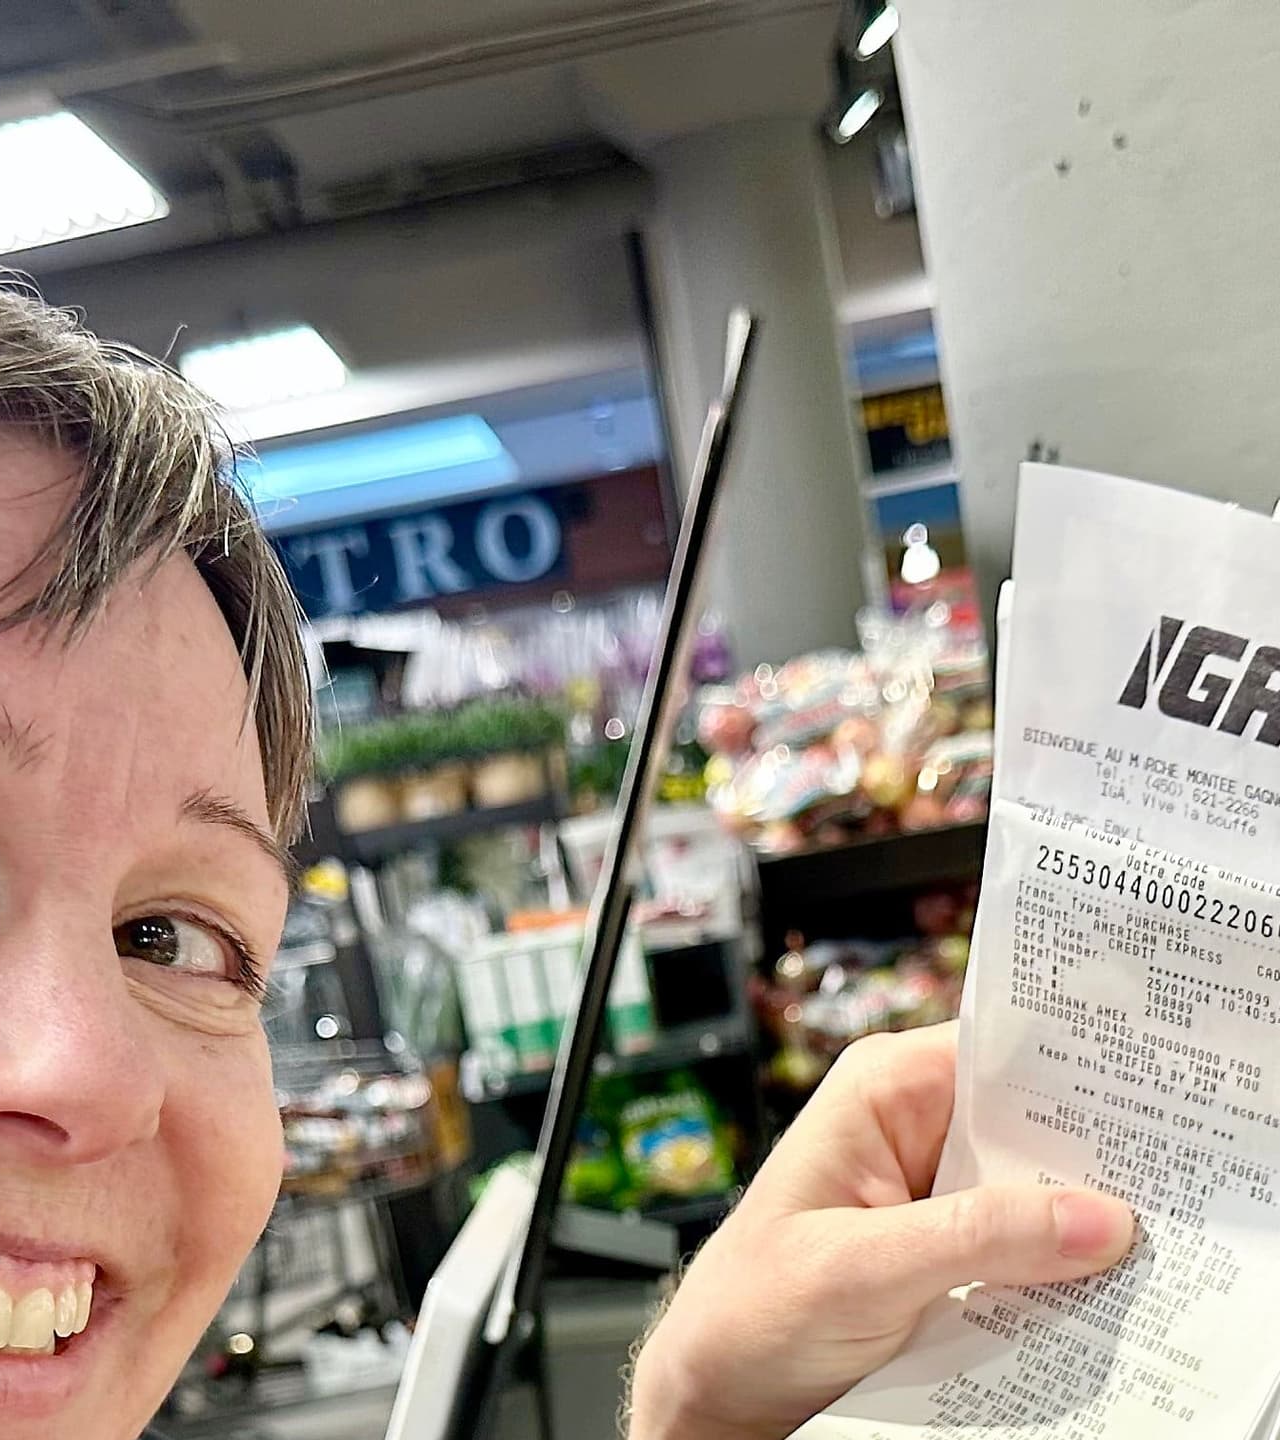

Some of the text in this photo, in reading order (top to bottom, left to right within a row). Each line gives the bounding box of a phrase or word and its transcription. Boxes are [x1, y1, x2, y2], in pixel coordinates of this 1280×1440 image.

[1022, 727, 1097, 759] BIENVENUE
[1105, 746, 1121, 764] AU
[1187, 767, 1236, 794] MONTEE
[1145, 773, 1184, 799] (450)
[1142, 791, 1174, 814] Vive
[1183, 803, 1199, 822] la
[1206, 811, 1258, 838] bouffe
[1125, 853, 1206, 892] Votre code
[1015, 911, 1045, 930] Card
[1054, 922, 1091, 944] Type:
[1108, 938, 1156, 960] CREDIT
[1016, 896, 1222, 965] Account: AMERICAN EXPRESS
[1072, 897, 1108, 918] Type:
[1127, 914, 1191, 941] PURCHASE
[1014, 926, 1044, 944] Card
[1053, 936, 1106, 962] Number:
[1014, 939, 1081, 969] DateTime:
[1147, 977, 1210, 1004] 25/01/04
[1012, 967, 1192, 1029] Auth 216558
[1012, 981, 1127, 1023] SCOTIABANK AMEX
[1071, 1025, 1260, 1093] 00 APPROVED THANK YOU
[1101, 1049, 1217, 1093] VERIFIED BY PIN
[1229, 1059, 1261, 1078] F800
[1039, 1044, 1280, 1128] Keep this copy for your records
[1025, 1108, 1090, 1140] HOMEDEPOT
[1103, 1092, 1203, 1133] CUSTOMER COPY
[1056, 1104, 1269, 1186] RECU ACTIVATION CARTE CADEAU
[1096, 1147, 1214, 1199] 01/04/2025 10:41
[1083, 1173, 1205, 1229] Transaction #9320
[1164, 1222, 1183, 1239] les
[1192, 1233, 1206, 1247] 24
[1148, 1267, 1205, 1300] LA CARTE
[1162, 1256, 1191, 1277] INFO
[1196, 1274, 1234, 1295] SOLDE
[1204, 1258, 1241, 1280] CETTE
[961, 1309, 1019, 1343] HOMEDEPOT
[991, 1304, 1175, 1395] RECU ACTIVATION CARTE CADEAU
[1016, 1351, 1081, 1389] 01/04/2025
[997, 1375, 1067, 1417] Transaction
[1033, 1412, 1060, 1431] dans
